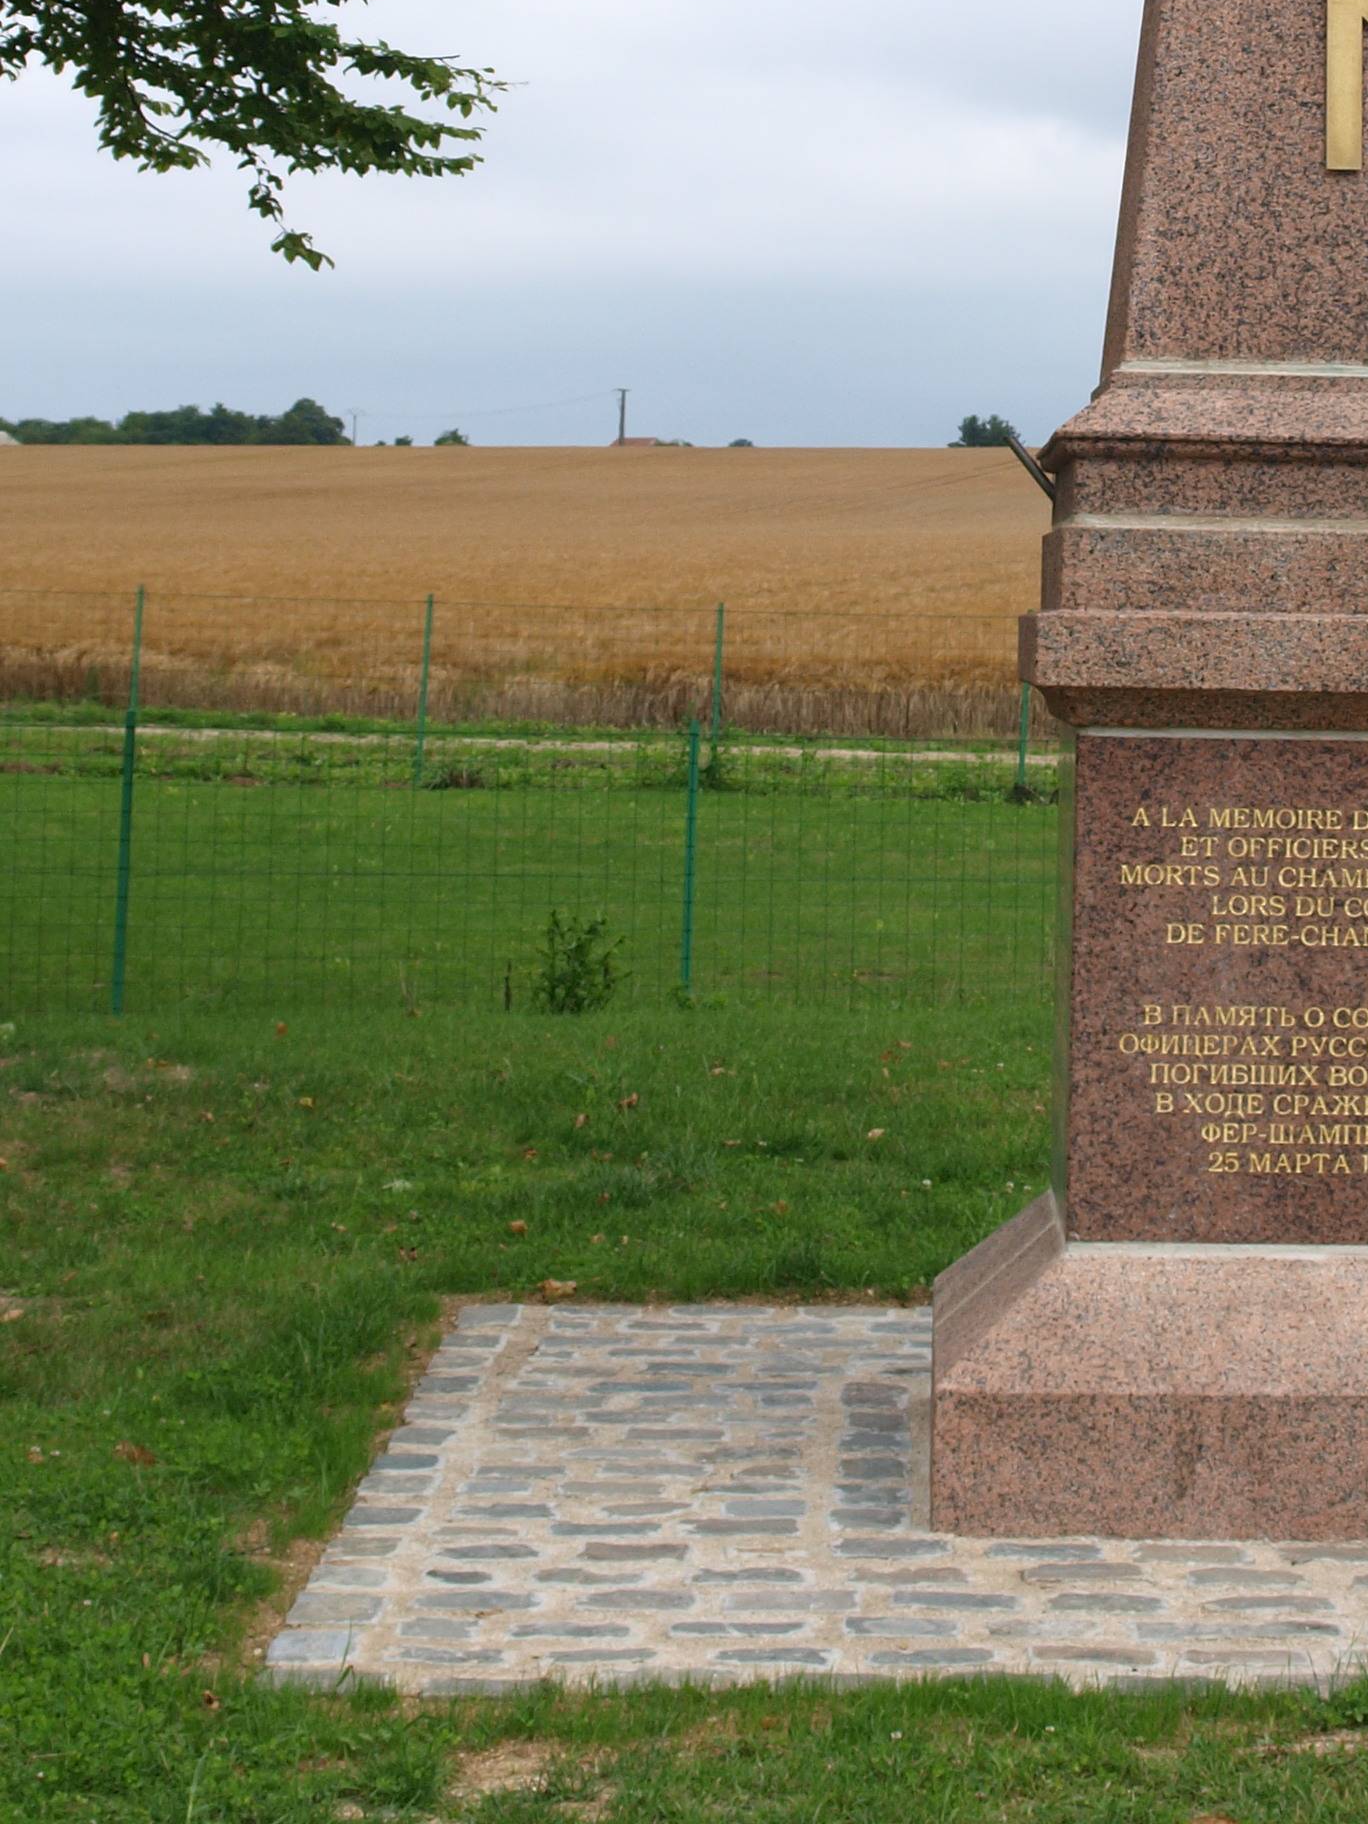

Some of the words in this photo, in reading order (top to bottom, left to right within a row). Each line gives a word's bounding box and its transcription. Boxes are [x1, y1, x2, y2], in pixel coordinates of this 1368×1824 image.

[1131, 807, 1151, 827] A
[1161, 808, 1198, 828] LA
[1209, 808, 1343, 830] MEMOIRE
[1180, 837, 1218, 858] ET
[1120, 865, 1220, 886] MORTS
[1231, 867, 1268, 888] AU
[1211, 895, 1286, 917] LORS
[1296, 897, 1334, 918] DU
[1167, 924, 1204, 945] DE
[1143, 1005, 1162, 1025] В
[1172, 1005, 1296, 1027] ПАМЯТЬ
[1304, 1008, 1325, 1028] О
[1150, 1064, 1318, 1086] ПОГИБШИХ
[1328, 1066, 1368, 1087] ВО
[1156, 1093, 1174, 1113] В
[1183, 1093, 1264, 1118] ХОДЕ
[1208, 1152, 1238, 1172] 25
[1249, 1153, 1350, 1174] МАРТА
